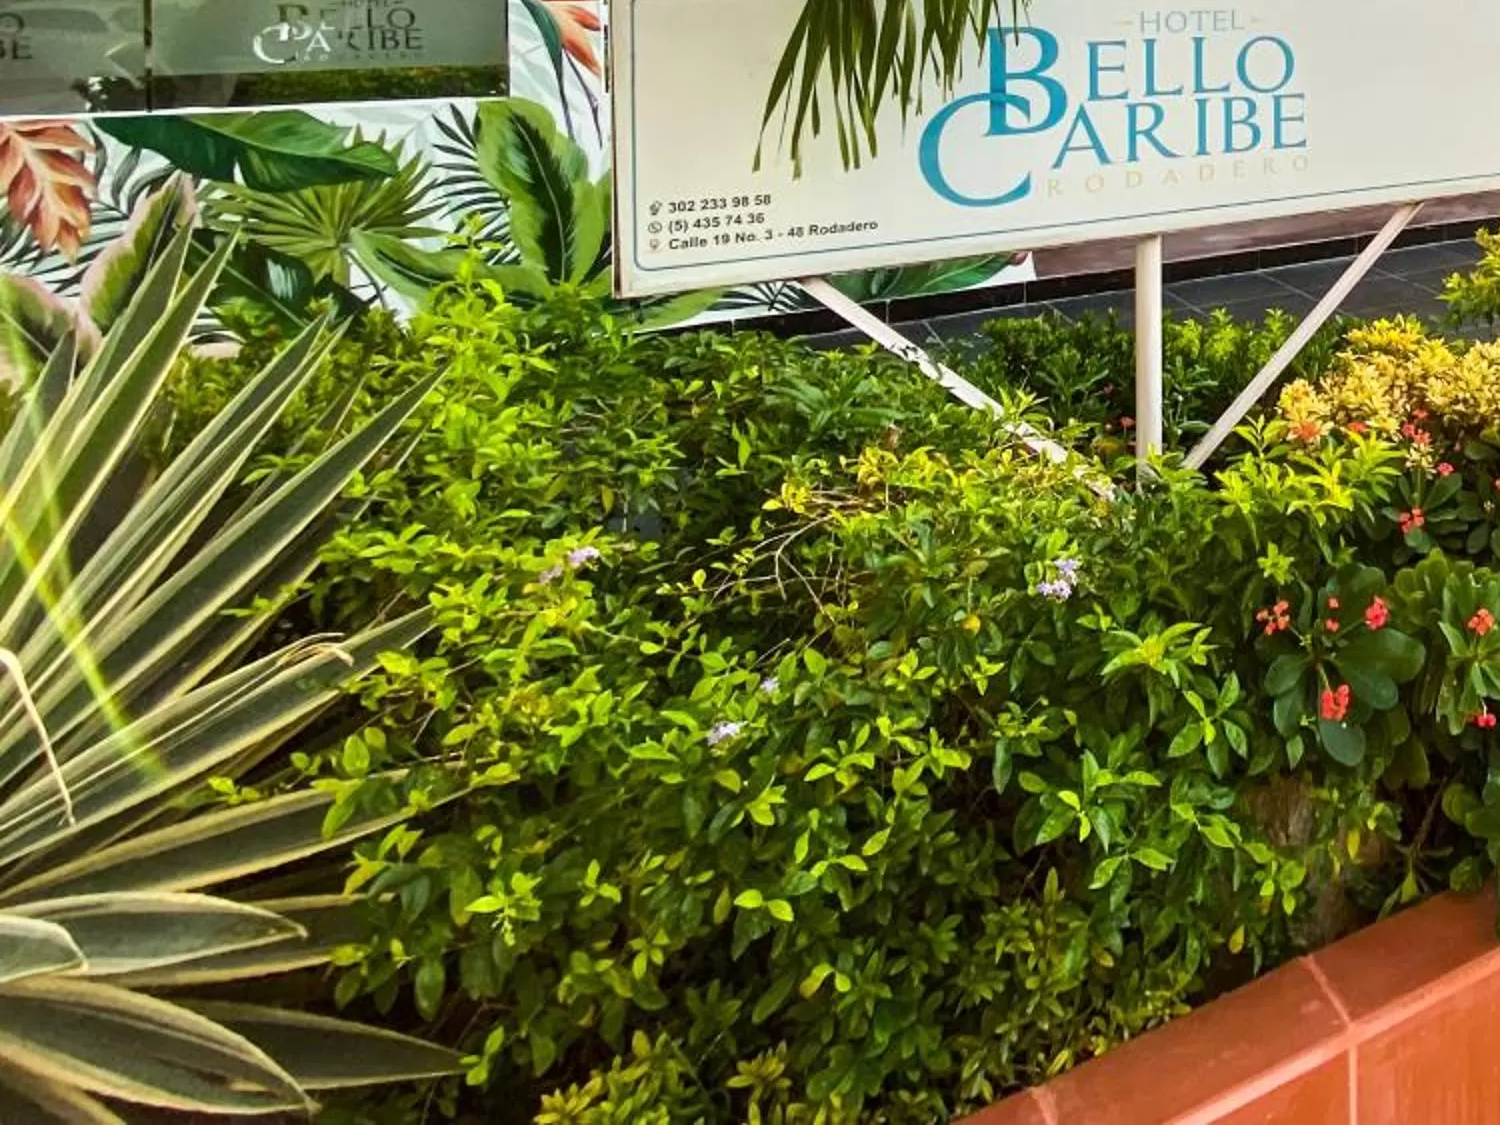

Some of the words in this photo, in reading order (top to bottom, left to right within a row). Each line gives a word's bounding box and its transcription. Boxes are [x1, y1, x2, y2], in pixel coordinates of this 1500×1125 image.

[1139, 8, 1246, 34] HOTEL
[982, 26, 1295, 137] BELLO
[919, 92, 1307, 208] CARIBE
[1046, 154, 1309, 198] RODADERO
[668, 200, 695, 214] 302
[700, 197, 727, 211] 233
[731, 195, 749, 208] 98
[754, 194, 771, 206] 58
[668, 220, 688, 235] (5)
[693, 215, 721, 229] 435
[725, 214, 743, 227] 74
[747, 212, 765, 225] 36
[668, 236, 708, 250] Calle
[713, 233, 730, 246] 19
[735, 231, 759, 244] No.
[764, 229, 774, 241] 3
[808, 220, 879, 236] Rodadero
